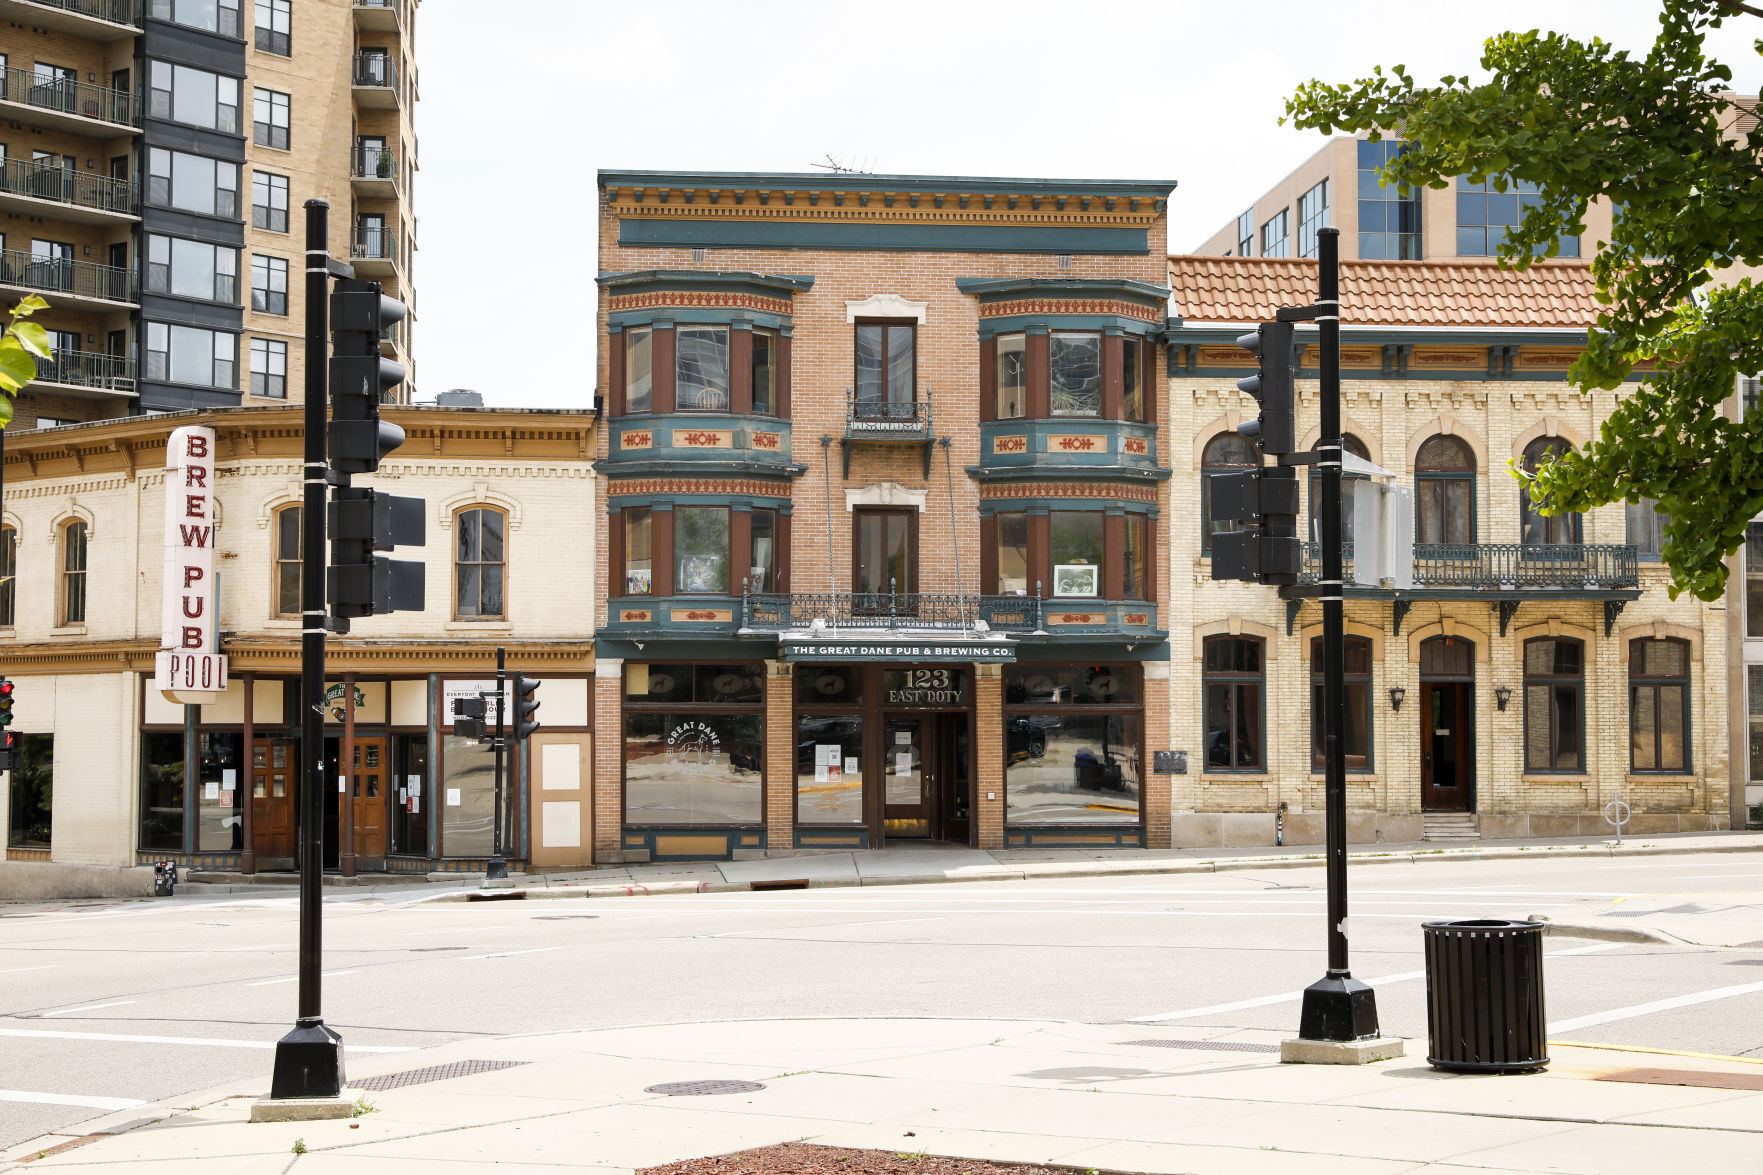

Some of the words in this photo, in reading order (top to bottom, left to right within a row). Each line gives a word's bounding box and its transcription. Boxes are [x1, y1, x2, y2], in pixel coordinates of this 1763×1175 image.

[179, 434, 210, 549] BREW
[181, 566, 204, 649] PUB
[792, 646, 816, 654] THE
[819, 647, 858, 655] GREAT
[860, 647, 893, 655] DANE
[896, 647, 920, 655] PUB
[935, 648, 990, 656] BREWING
[992, 648, 1012, 656] CO.
[169, 655, 226, 689] POOL
[904, 669, 949, 688] 123
[889, 690, 921, 703] EAST
[926, 690, 962, 703] DOTY
[667, 721, 695, 745] GREAT
[698, 722, 720, 745] DANE
